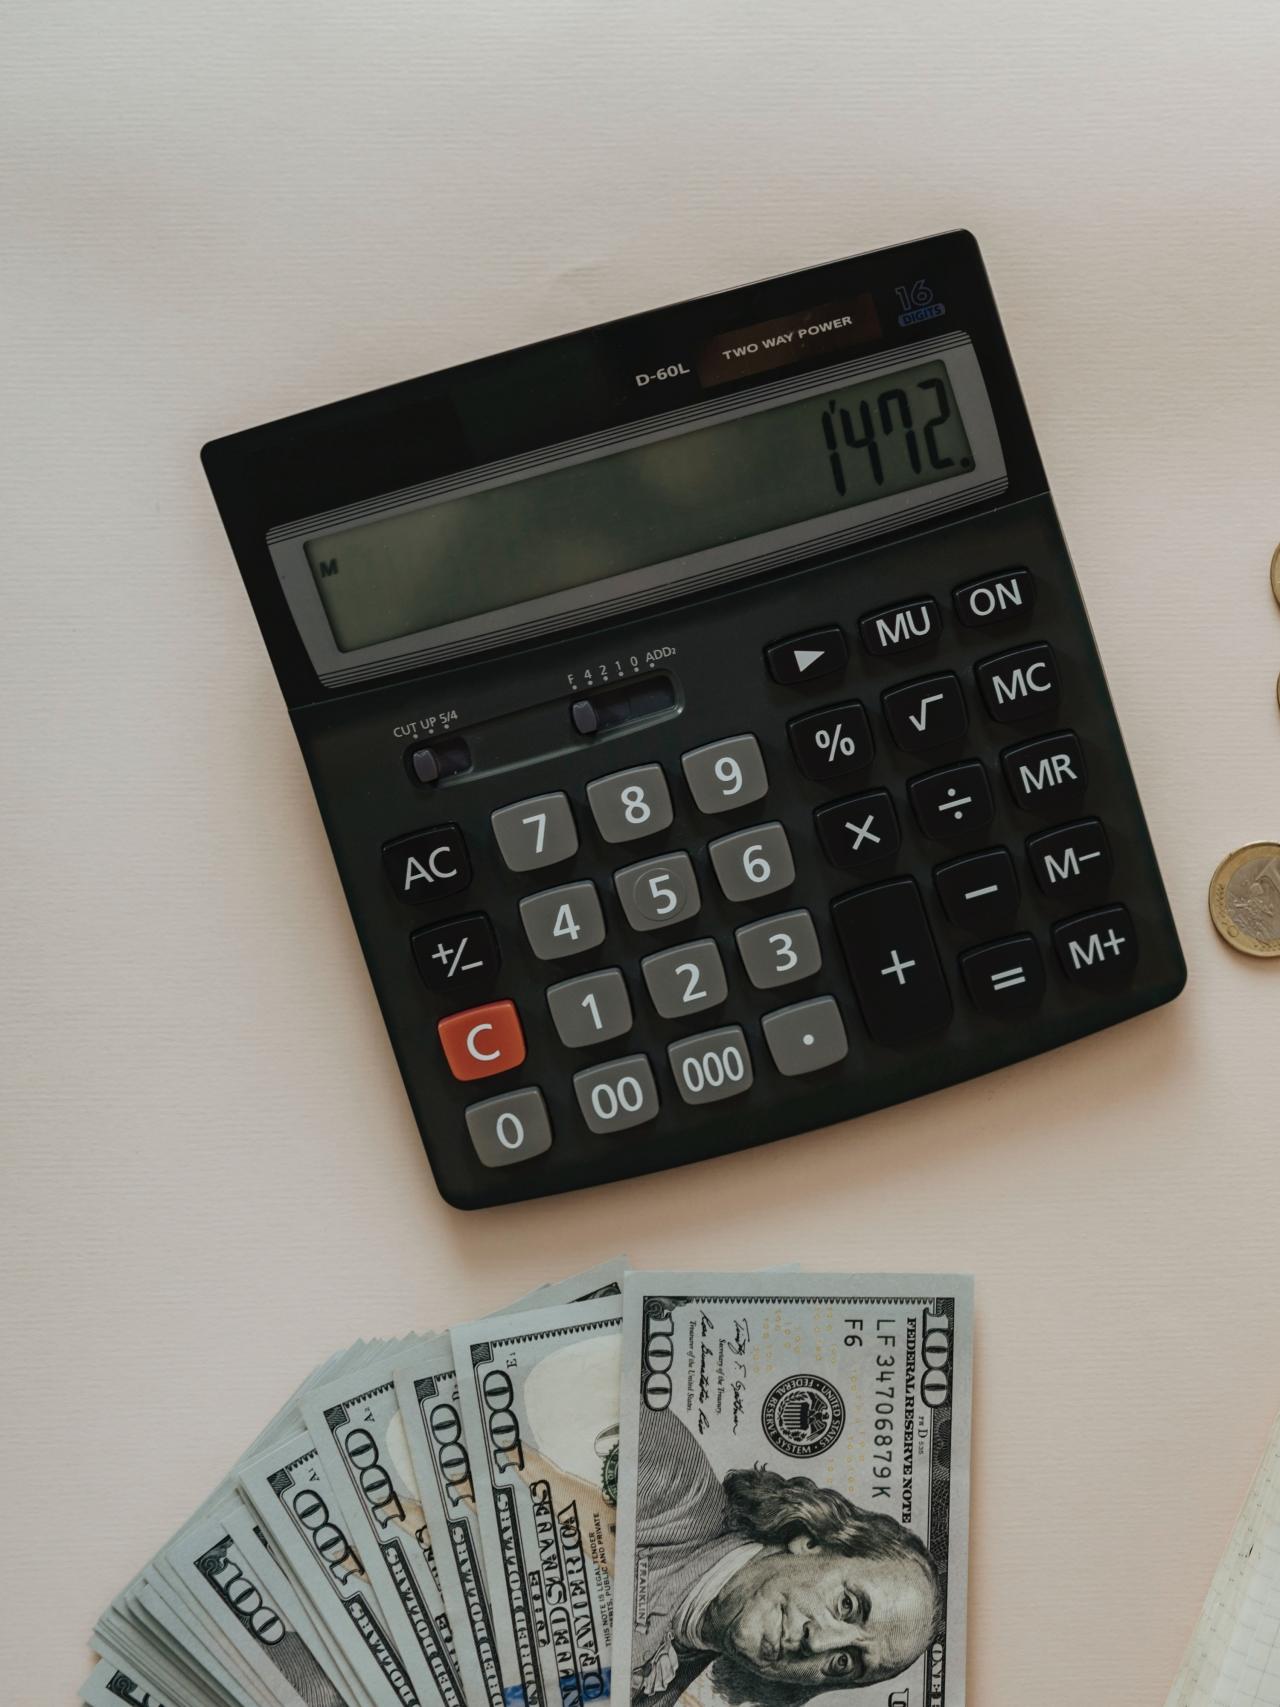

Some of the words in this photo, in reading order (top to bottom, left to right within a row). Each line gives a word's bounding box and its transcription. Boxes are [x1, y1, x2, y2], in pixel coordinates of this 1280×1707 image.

[894, 279, 934, 311] 16
[901, 305, 943, 325] DIGITS
[722, 343, 759, 360] TWO
[761, 330, 794, 349] WAY
[797, 315, 853, 340] POWER
[635, 362, 691, 386] D-60L
[319, 558, 339, 578] M
[969, 578, 1023, 616] ON
[875, 606, 931, 647] MU
[567, 674, 575, 685] F
[584, 669, 593, 680] 4
[599, 665, 608, 676] 2
[615, 660, 622, 671] 1
[630, 656, 639, 667] 0
[992, 662, 1052, 704] MC
[393, 722, 417, 737] CUT
[419, 716, 438, 729] UP
[438, 709, 458, 724] 5/4
[815, 723, 855, 762] %
[714, 756, 743, 796] 9
[1019, 754, 1078, 794] MR
[620, 785, 651, 824] 8
[522, 813, 546, 854] 7
[404, 846, 457, 891] AC
[742, 844, 771, 883] 6
[648, 874, 677, 915] 5
[553, 903, 581, 940] 4
[768, 933, 798, 972] 3
[1068, 928, 1126, 969] M+
[675, 963, 707, 1003] 2
[581, 993, 603, 1030] 1
[466, 1023, 501, 1061] C
[682, 1046, 744, 1092] 000
[591, 1076, 644, 1120] 00
[496, 1112, 524, 1149] 0
[843, 1318, 864, 1347] F6
[874, 1317, 897, 1348] LF
[642, 1303, 675, 1412] 100
[903, 1316, 918, 1392] FEDERAL
[920, 1306, 951, 1408] 100
[482, 1368, 525, 1474] 100
[869, 1354, 897, 1479] 34706879
[900, 1394, 916, 1465] RESERVE
[429, 1402, 477, 1508] 100
[344, 1426, 406, 1530] 100
[871, 1485, 890, 1498] K
[898, 1467, 913, 1524] NOTE
[292, 1487, 366, 1587] 100
[218, 1556, 288, 1648] 100
[637, 1560, 648, 1621] FRANKLIN
[931, 1643, 942, 1691] ONE
